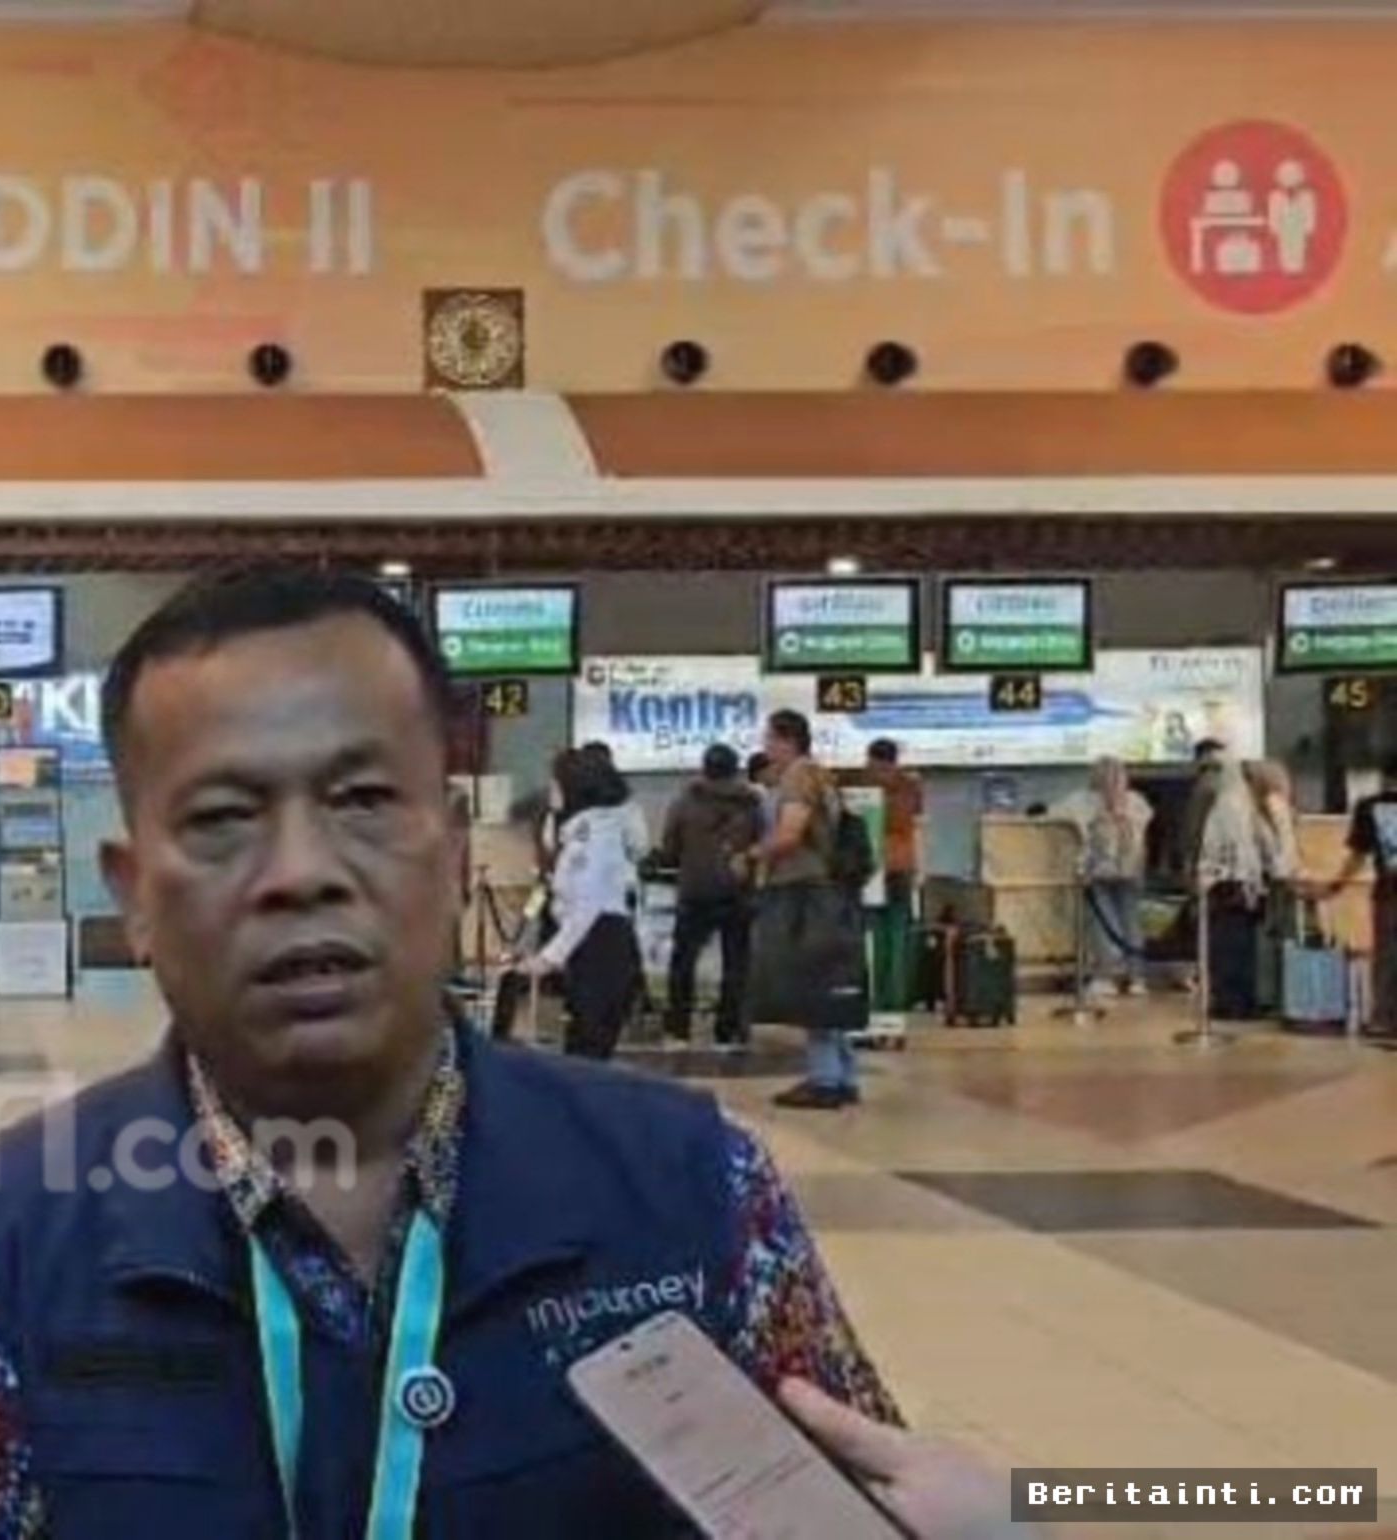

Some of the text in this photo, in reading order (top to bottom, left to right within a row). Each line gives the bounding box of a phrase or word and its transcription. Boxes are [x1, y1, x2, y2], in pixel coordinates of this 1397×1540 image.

[308, 176, 374, 275] II
[542, 166, 1117, 283] Check-In
[484, 684, 524, 716] 42
[822, 681, 864, 709] 43
[996, 679, 1036, 706] 44
[1329, 680, 1368, 708] 45
[608, 688, 759, 732] Kontra
